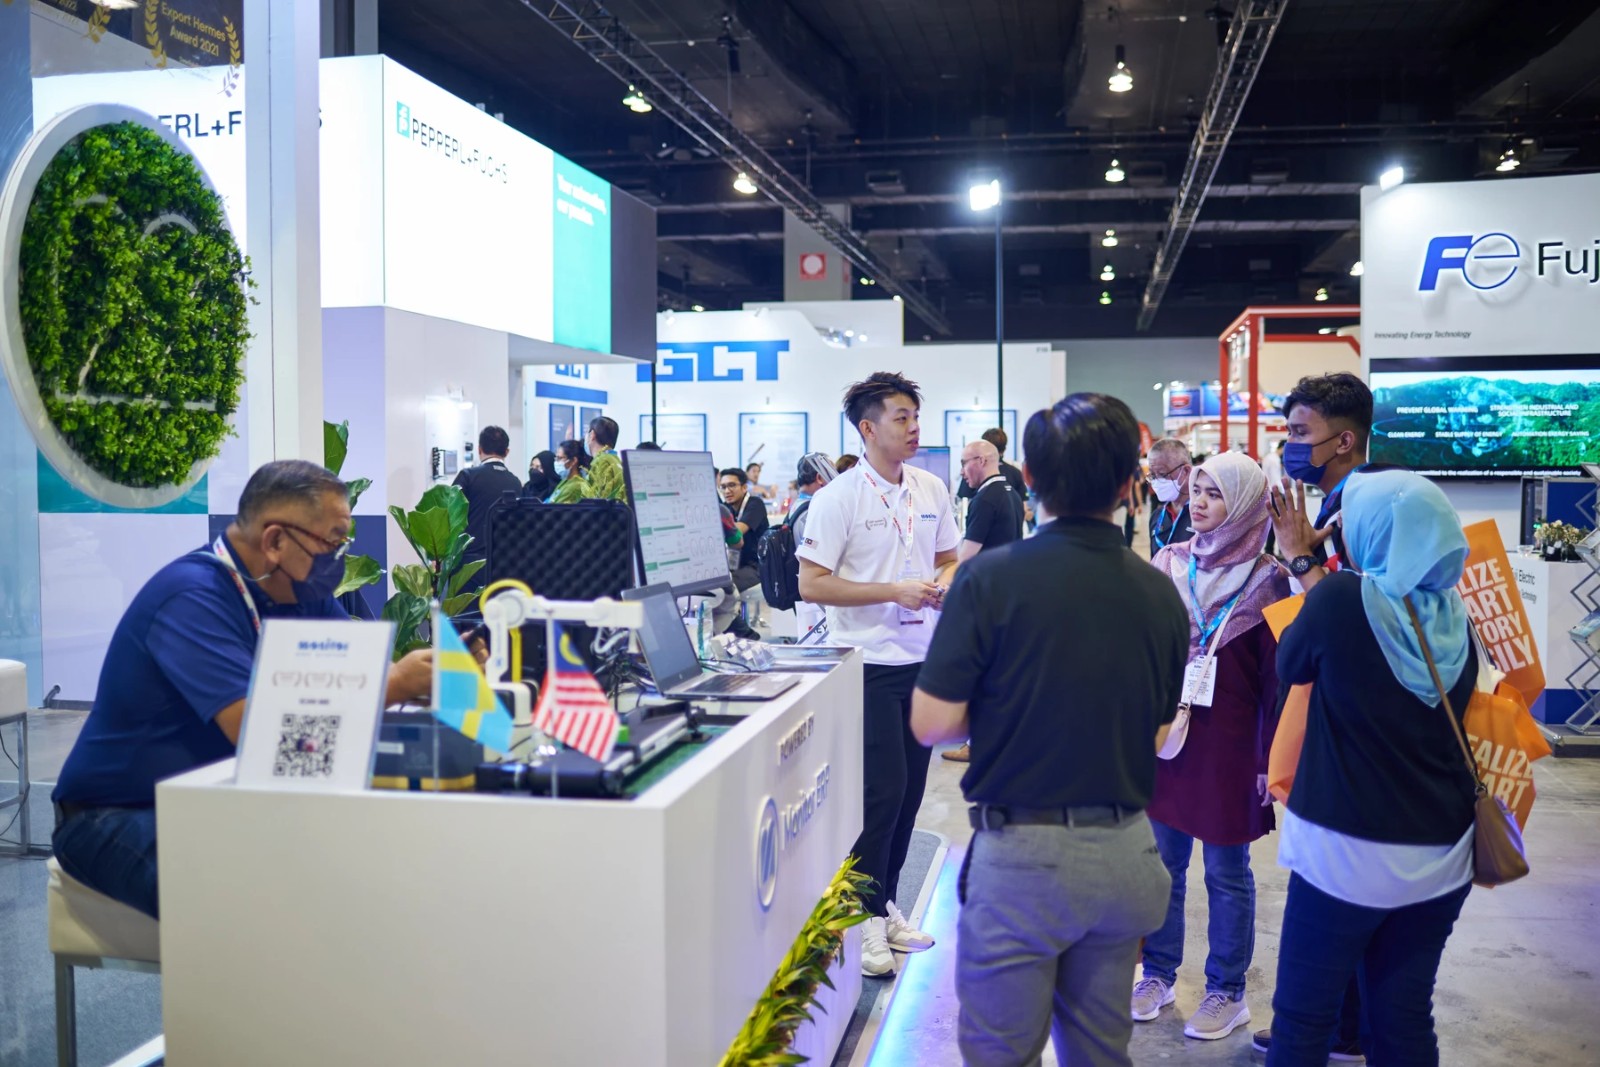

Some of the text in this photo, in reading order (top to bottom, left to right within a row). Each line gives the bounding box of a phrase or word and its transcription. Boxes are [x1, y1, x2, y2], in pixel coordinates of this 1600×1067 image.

[161, 1, 227, 42] Export Hermes
[169, 25, 199, 48] Award
[1374, 330, 1472, 340] Innovating Energy Technology
[1396, 406, 1423, 414] PREVENT
[1423, 406, 1447, 414] GLOBAL
[1455, 558, 1506, 596] LIZE
